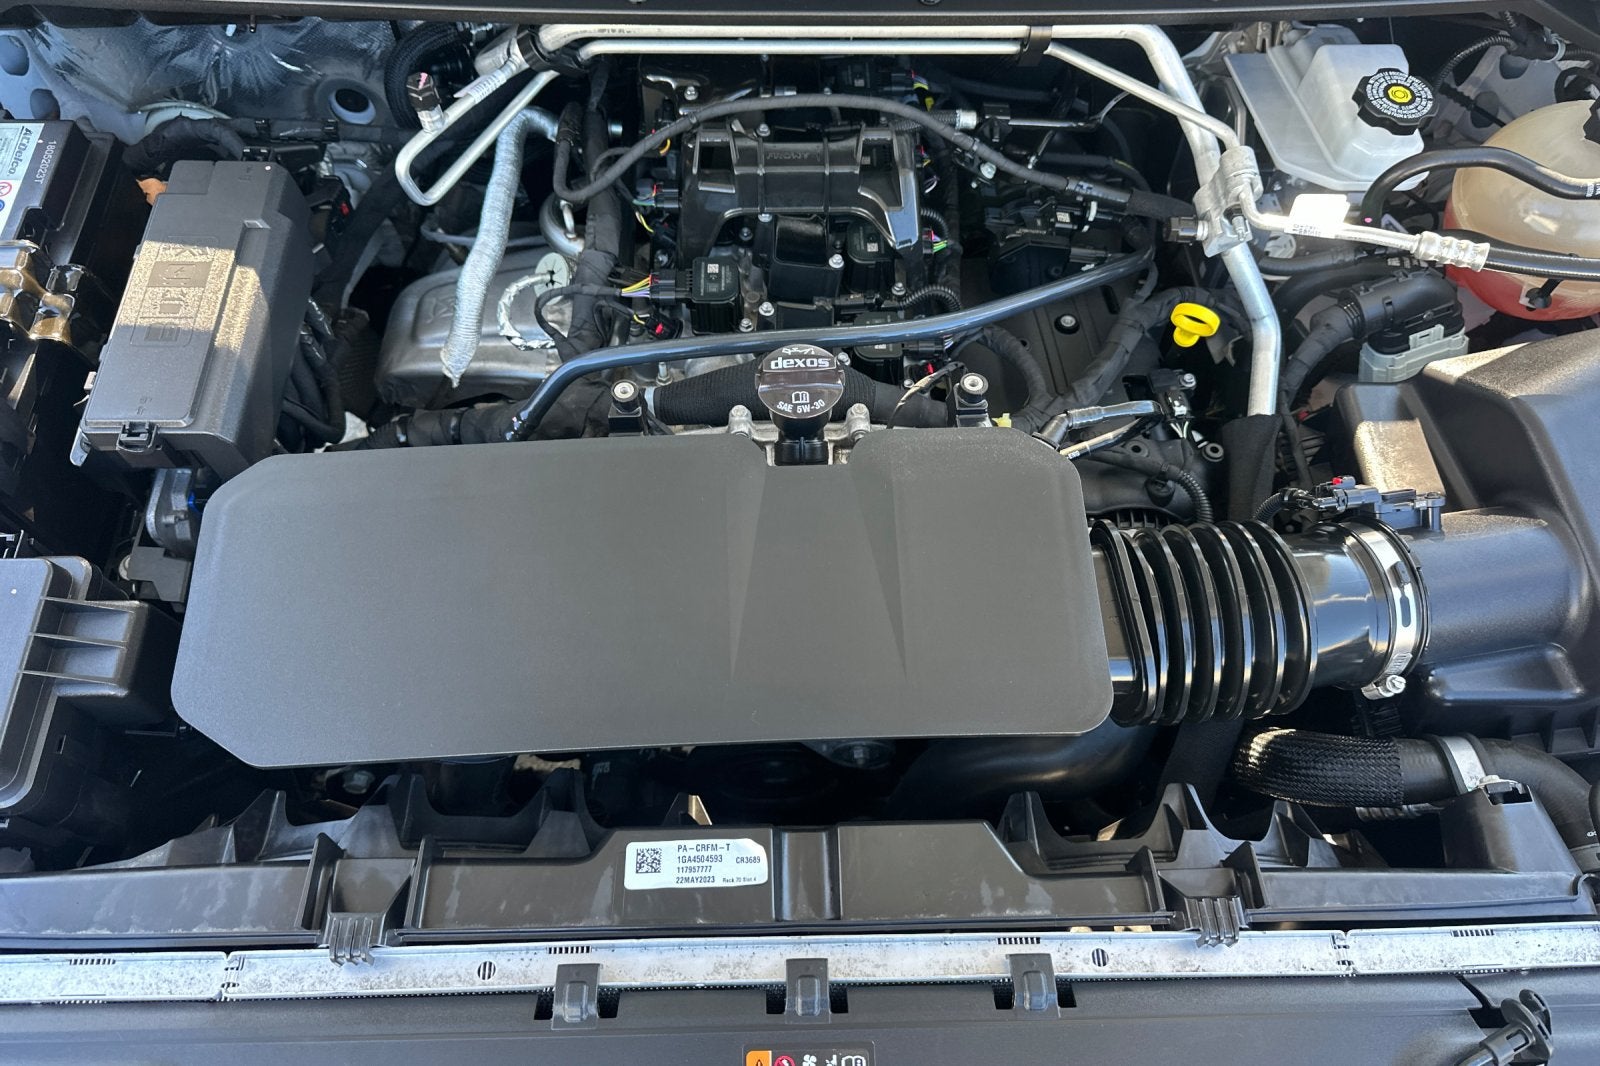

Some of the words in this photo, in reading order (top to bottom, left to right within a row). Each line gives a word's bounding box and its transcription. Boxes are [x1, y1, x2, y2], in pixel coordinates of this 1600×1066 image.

[8, 128, 33, 174] ACDelco
[35, 140, 57, 185] 18052023T
[770, 356, 830, 370] dexos
[776, 400, 793, 413] SAE
[796, 398, 826, 413] 5W-30
[677, 854, 723, 864] 1GA4504593
[735, 855, 761, 864] CR3689
[676, 865, 712, 873] 117957777
[675, 875, 716, 884] 22MAY2023
